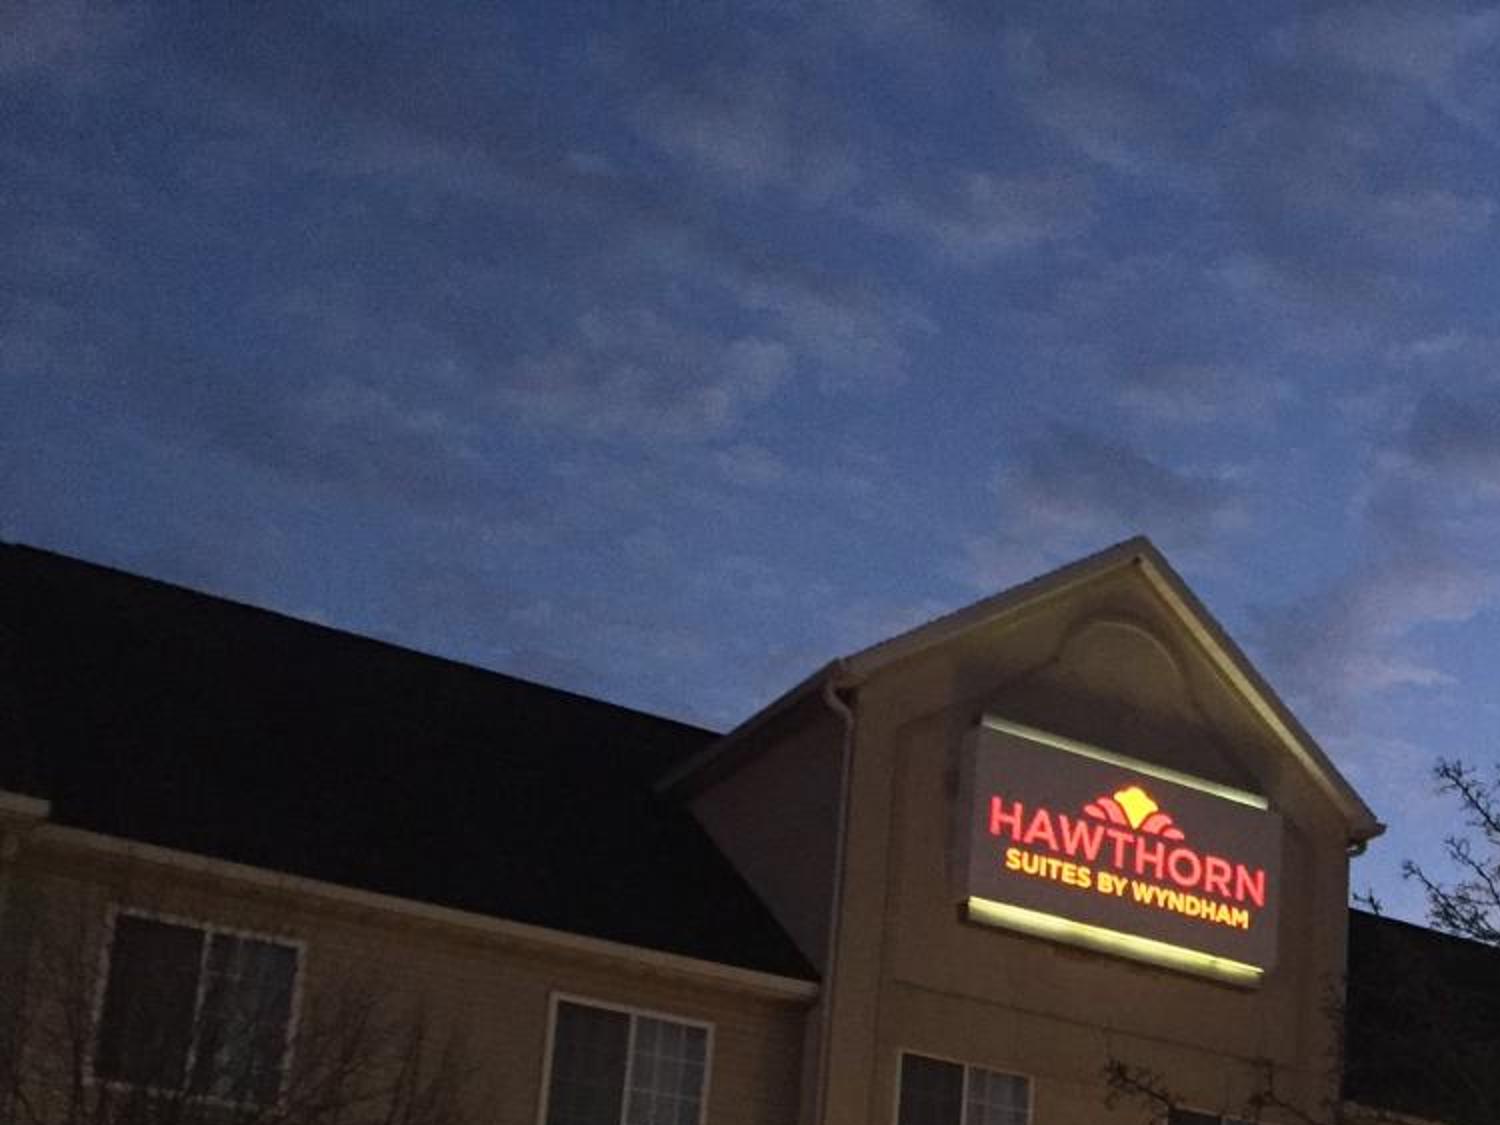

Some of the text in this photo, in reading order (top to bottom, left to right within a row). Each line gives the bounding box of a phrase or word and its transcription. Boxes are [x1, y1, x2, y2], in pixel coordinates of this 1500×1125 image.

[990, 796, 1266, 907] HAWTHORN
[1005, 848, 1250, 929] SUITES BY WYNDHAM
